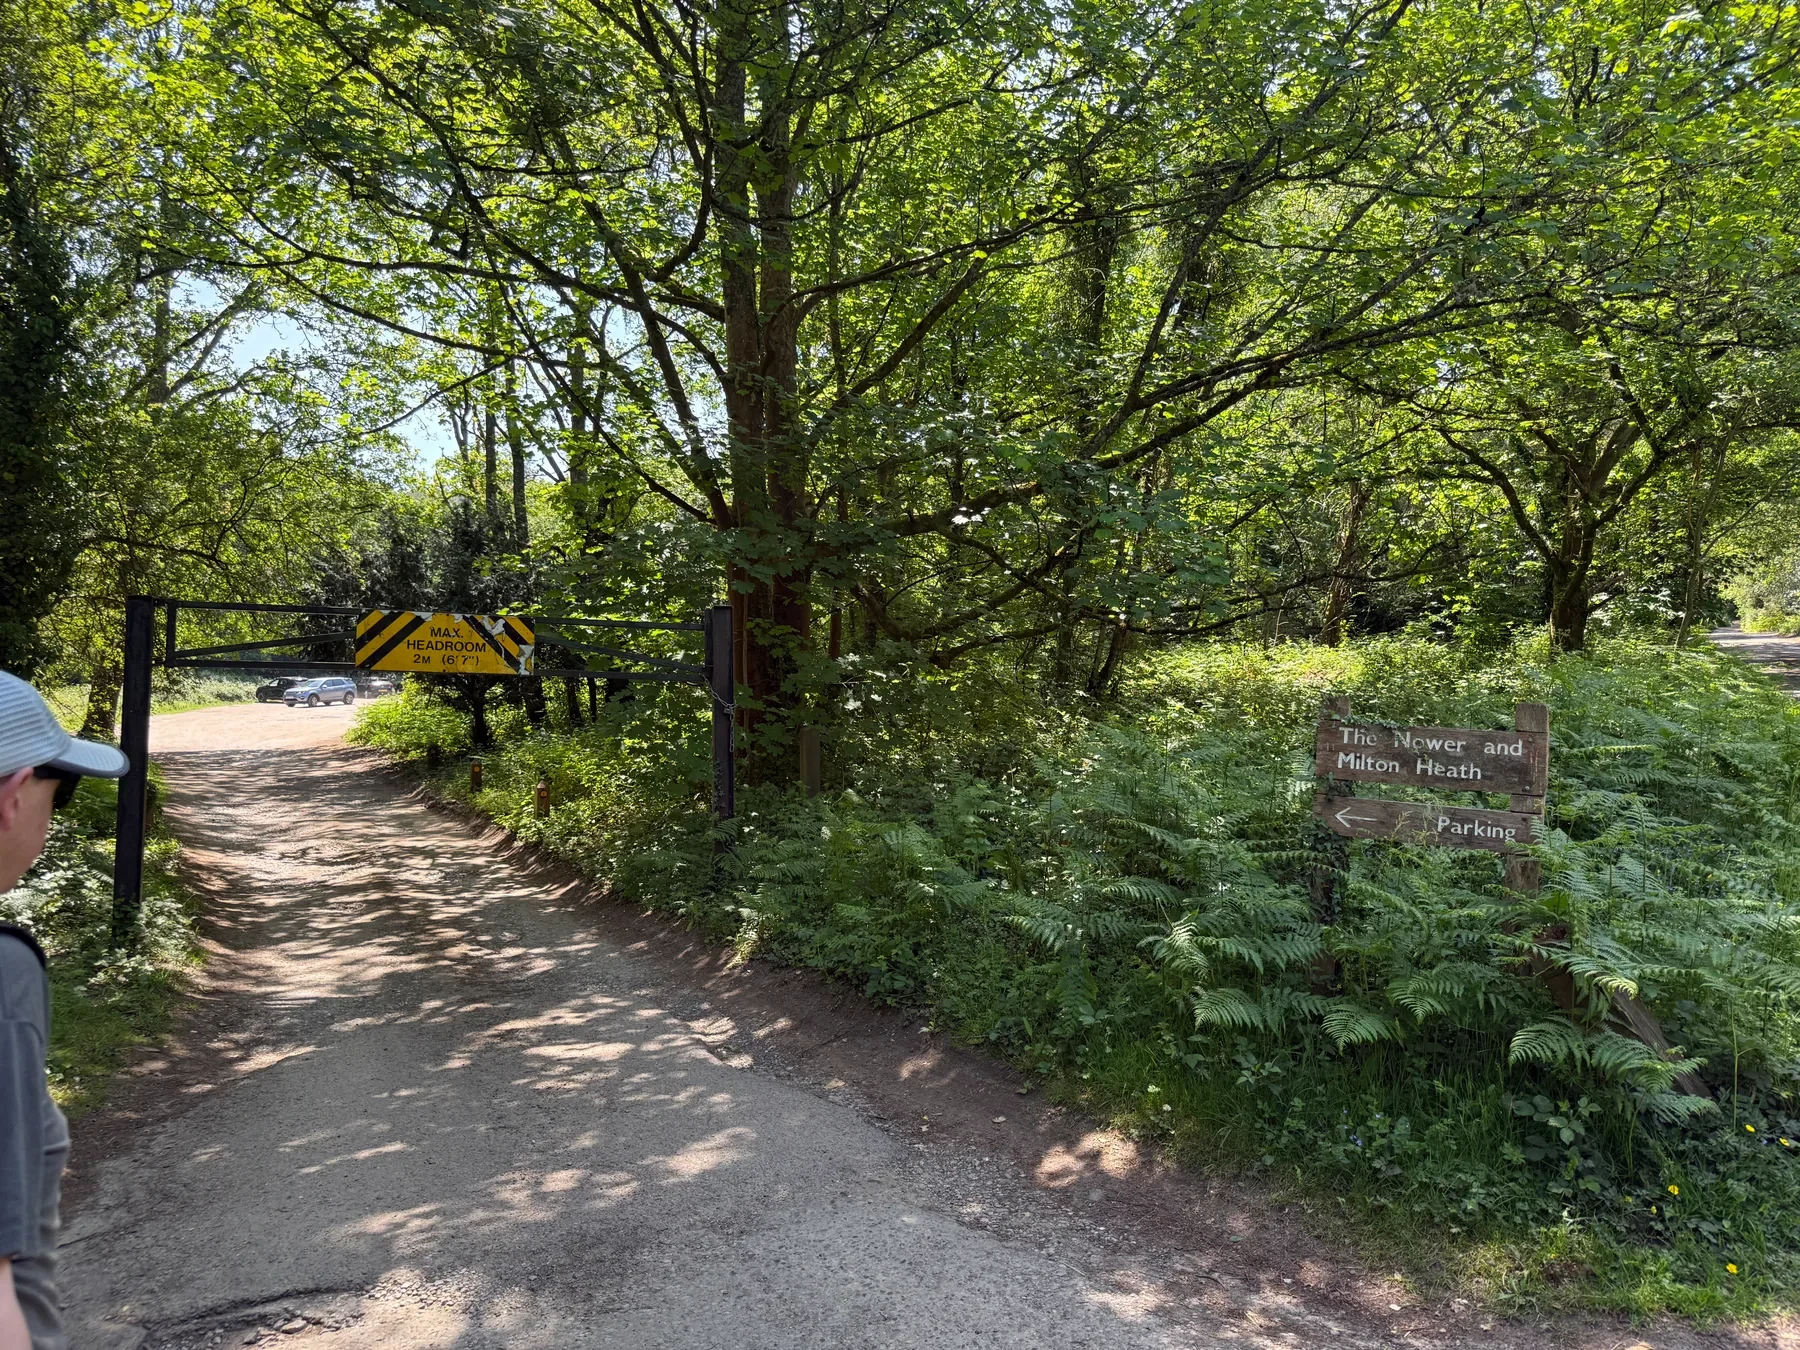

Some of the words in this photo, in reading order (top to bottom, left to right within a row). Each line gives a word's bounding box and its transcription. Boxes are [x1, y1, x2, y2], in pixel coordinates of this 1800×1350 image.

[430, 627, 464, 638] MAX.
[407, 640, 486, 652] HEADROOM
[1338, 727, 1377, 746] The
[1395, 730, 1466, 752] Nower
[1484, 739, 1523, 756] and
[1337, 752, 1399, 773] Milton
[1416, 758, 1482, 780] Heath
[1437, 816, 1516, 842] Parking
